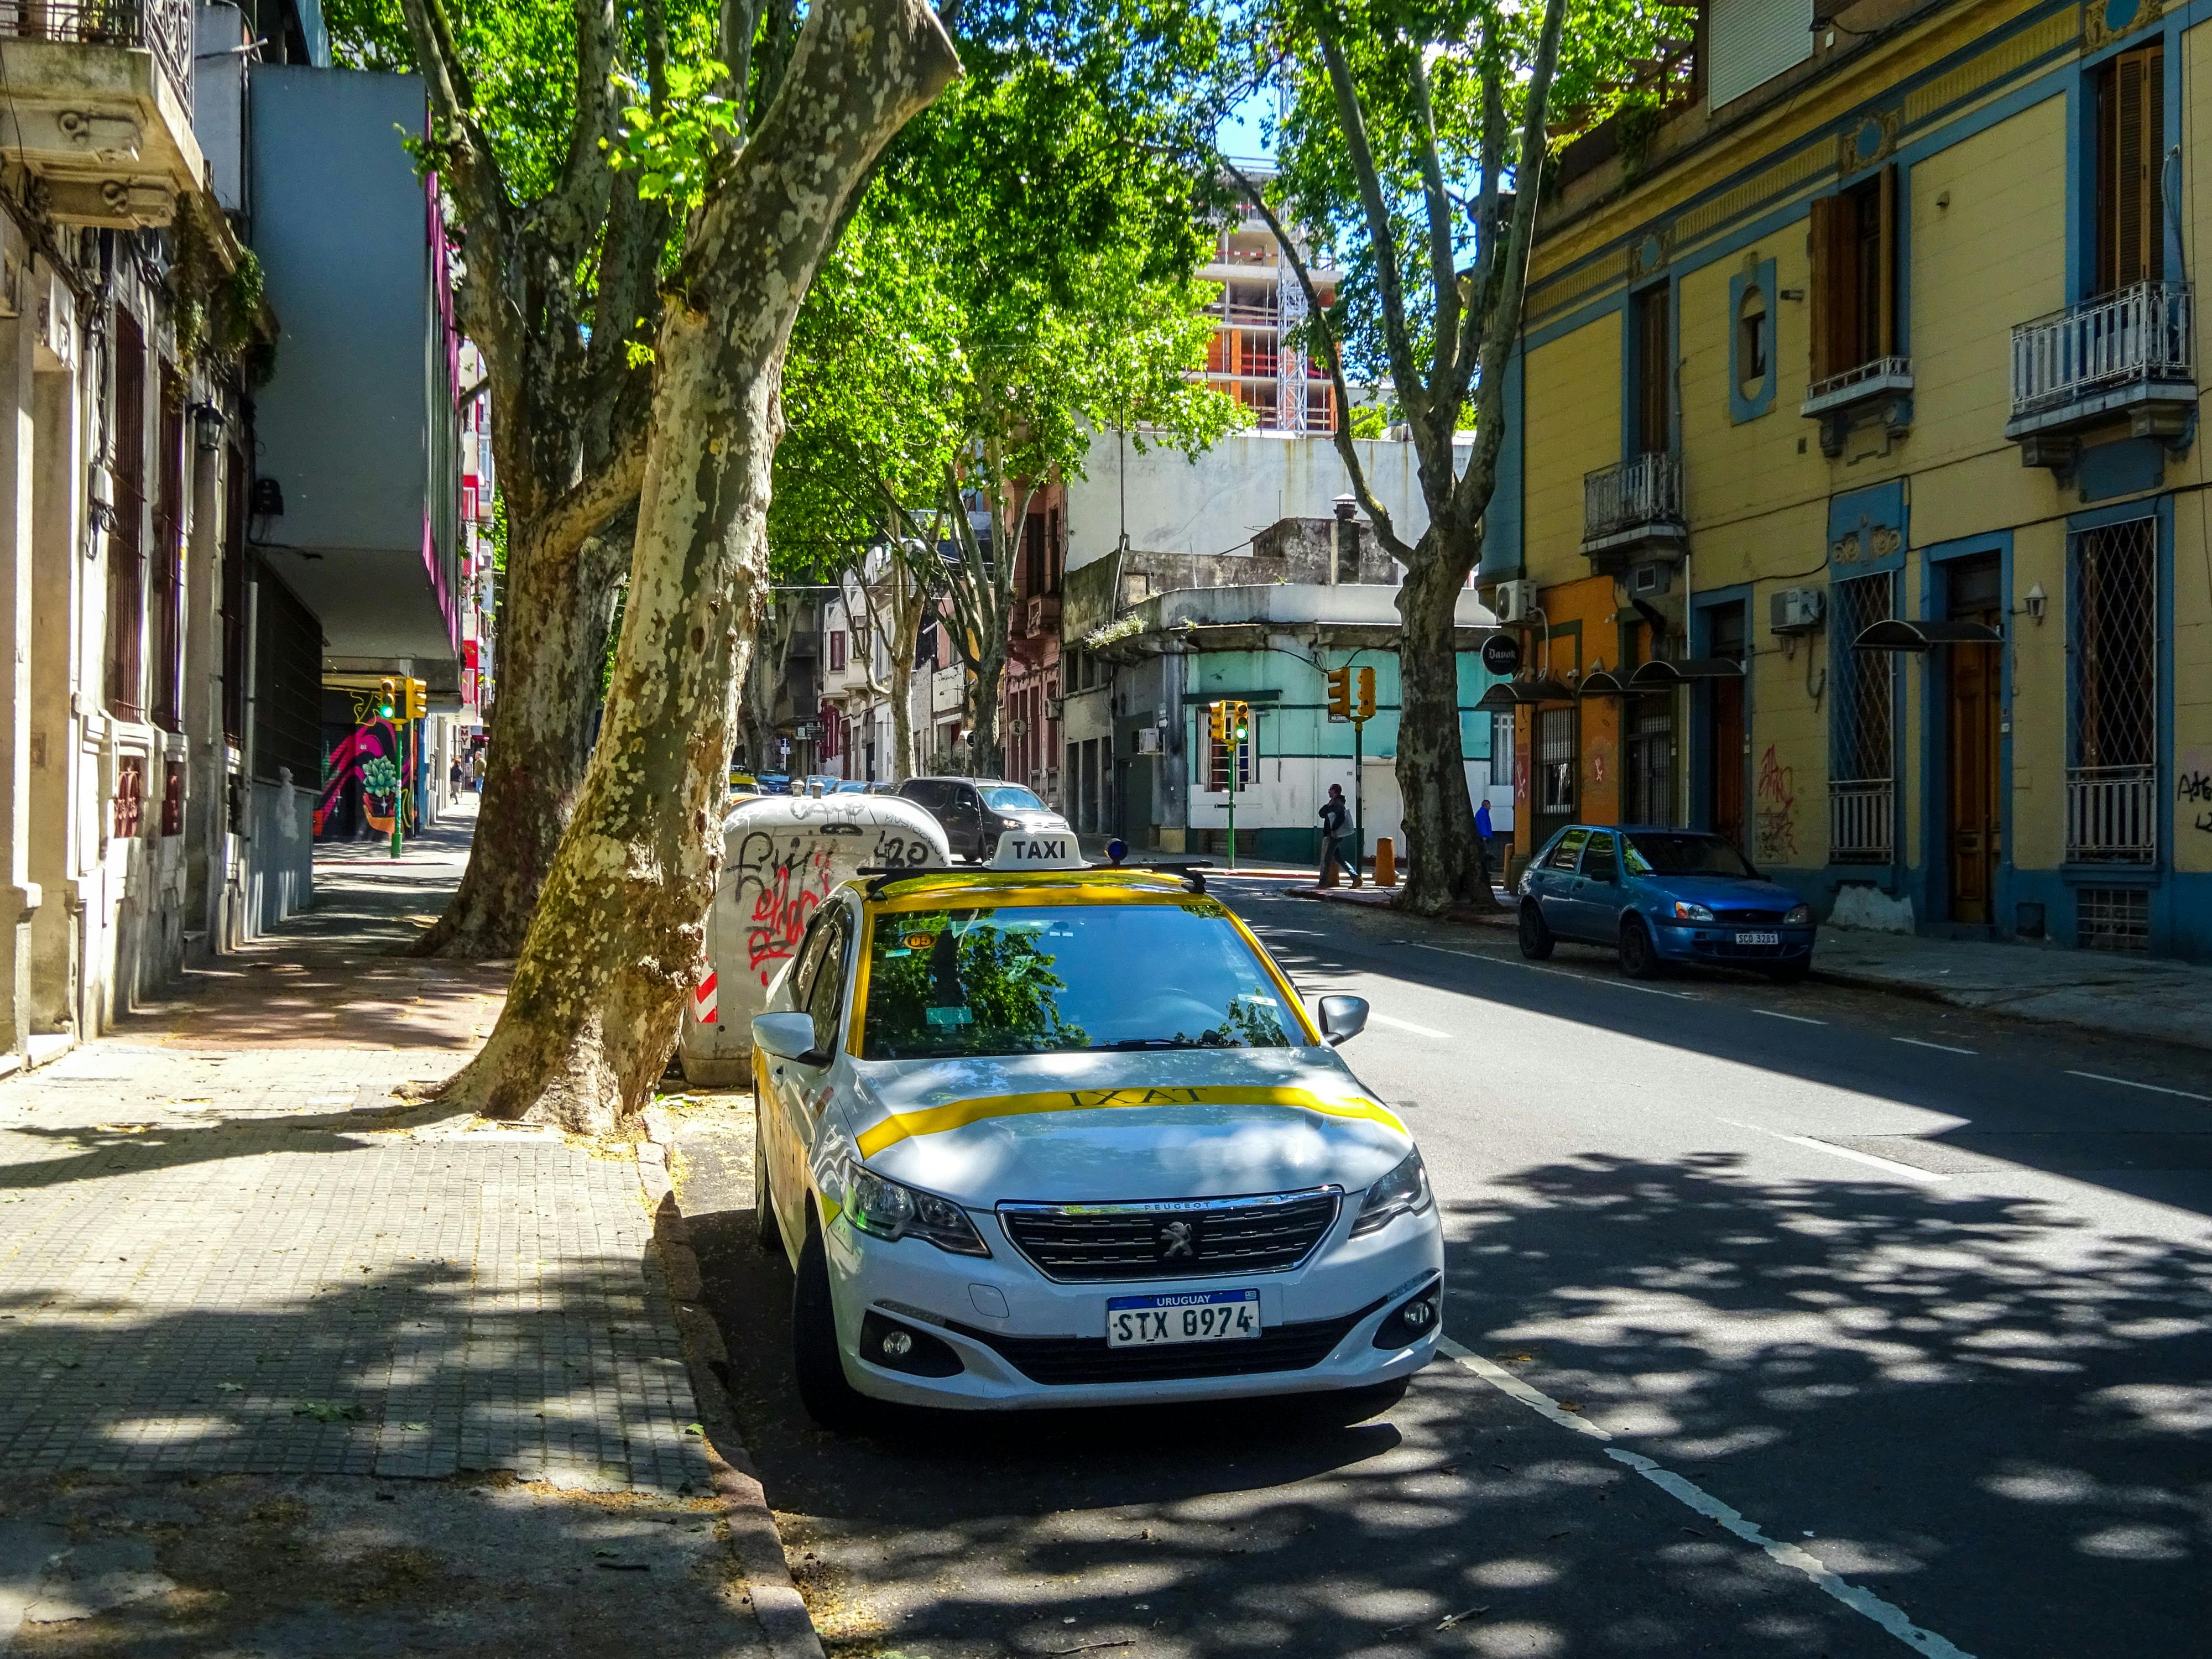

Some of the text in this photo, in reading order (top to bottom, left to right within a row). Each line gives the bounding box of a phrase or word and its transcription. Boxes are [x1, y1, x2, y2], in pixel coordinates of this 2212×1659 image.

[873, 830, 928, 866] 420
[1012, 841, 1066, 859] TAXI
[1144, 1202, 1211, 1211] PEUGEOT
[1157, 1295, 1211, 1307] URUGUAY
[1118, 1311, 1168, 1342] STX
